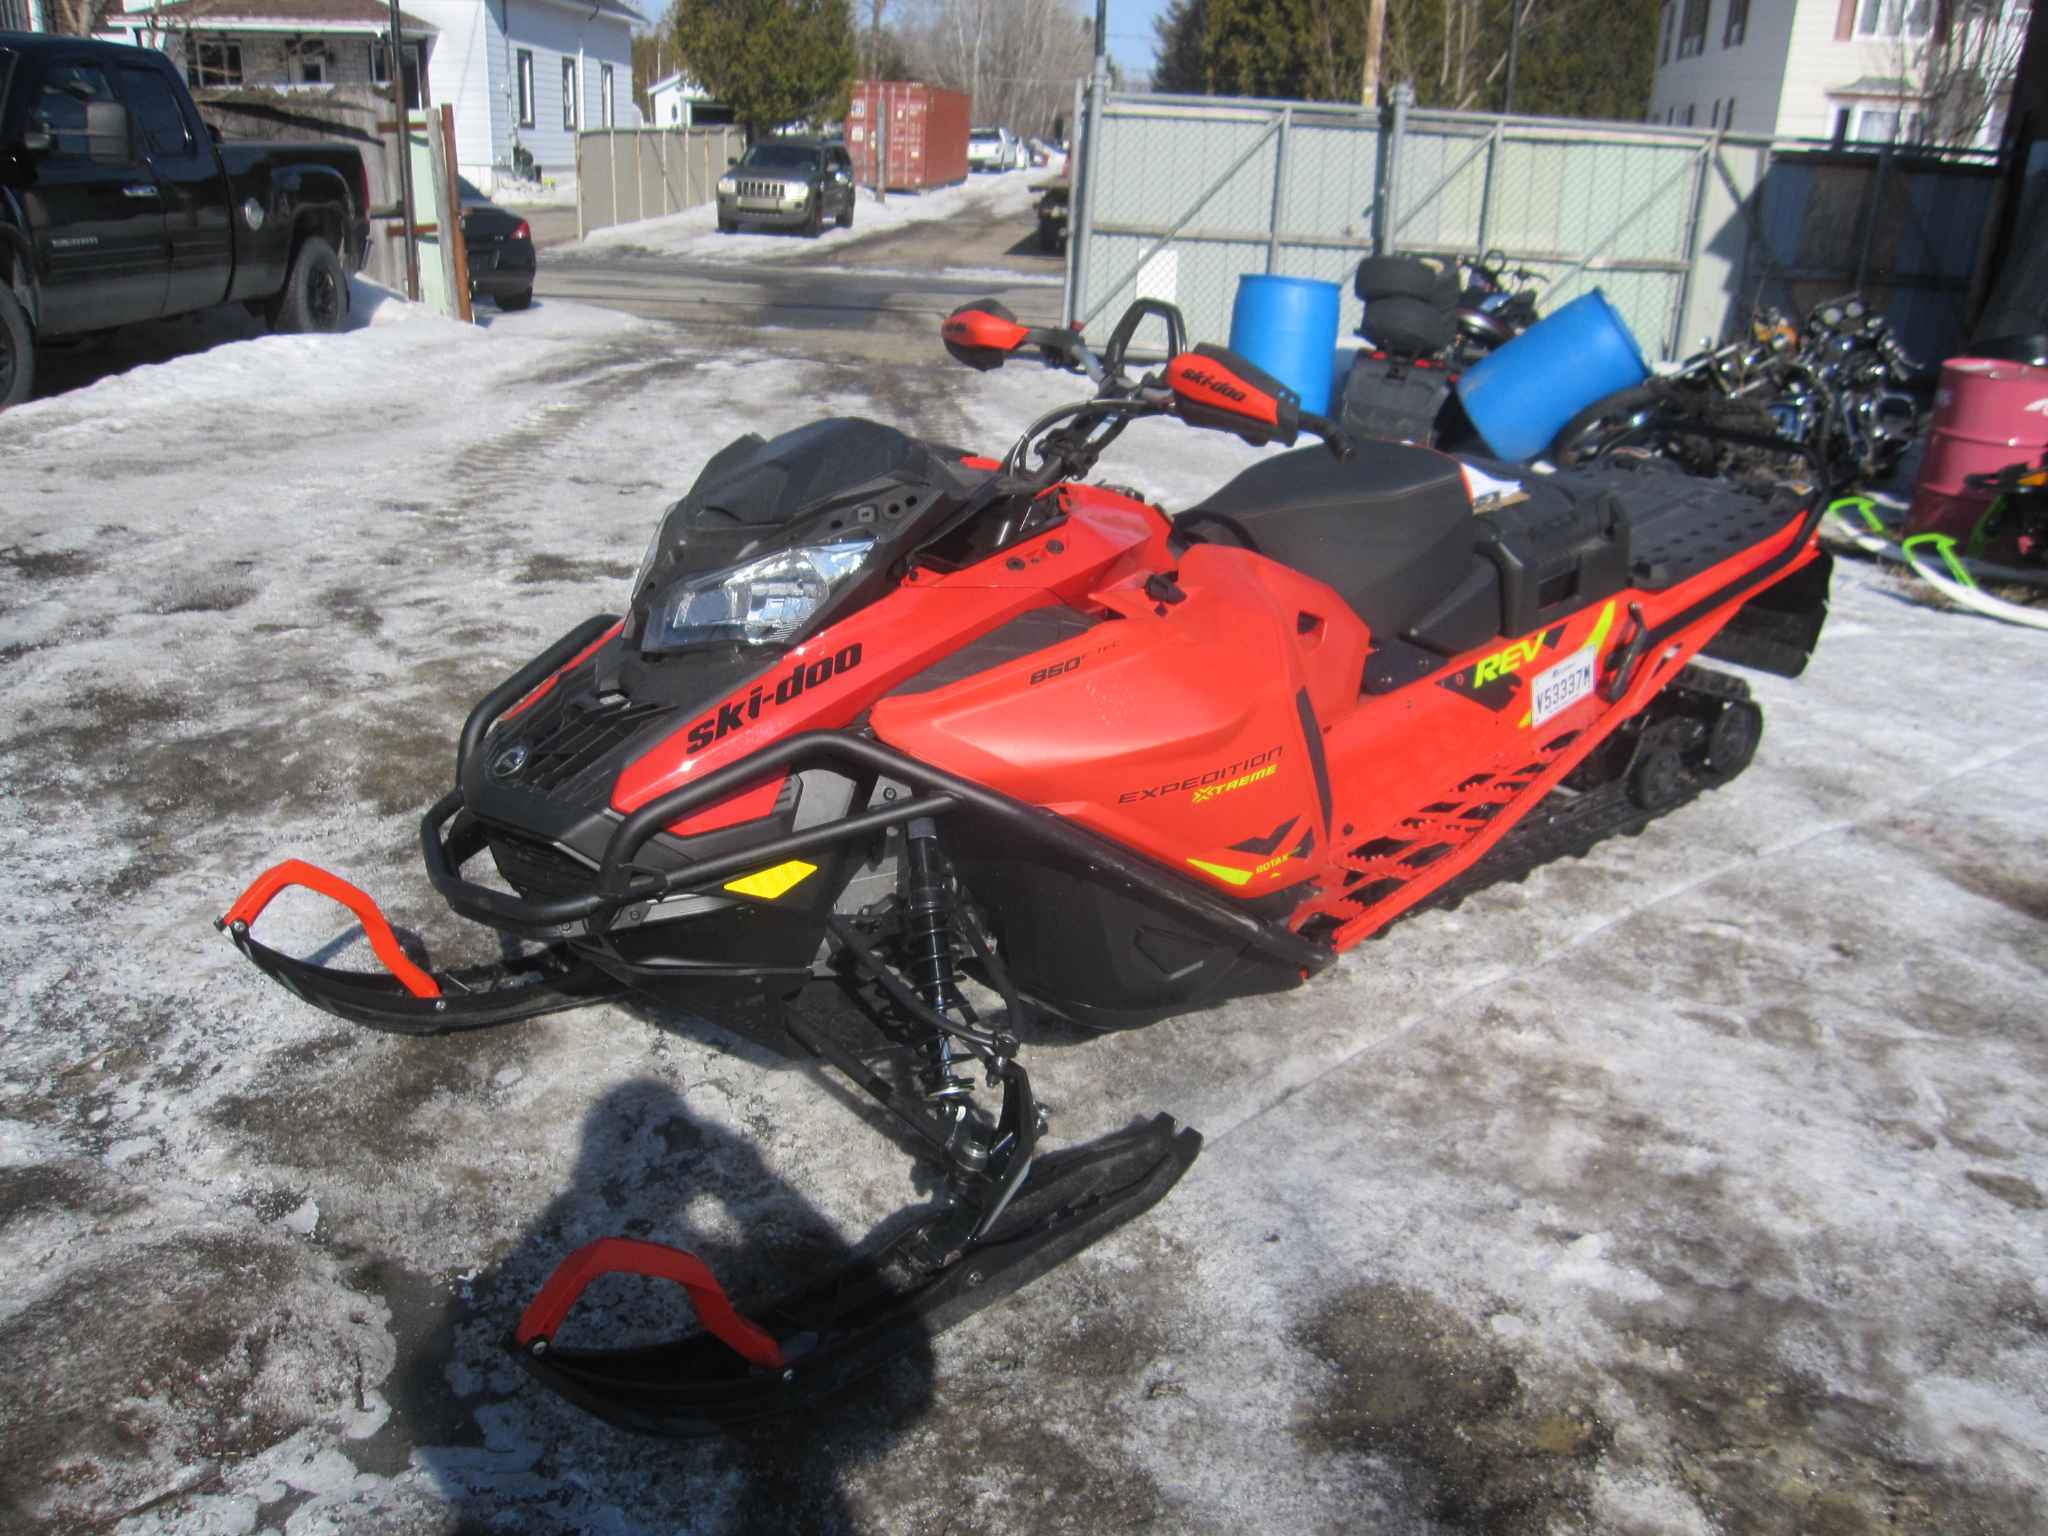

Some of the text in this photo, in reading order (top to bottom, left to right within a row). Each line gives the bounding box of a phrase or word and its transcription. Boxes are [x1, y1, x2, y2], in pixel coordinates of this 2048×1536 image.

[1181, 368, 1247, 402] ski-doo
[1030, 656, 1081, 685] 850
[1473, 630, 1547, 689] REV
[686, 642, 863, 755] ski-doo
[1118, 746, 1283, 804] EXPEDITION
[1192, 764, 1278, 803] XTREME
